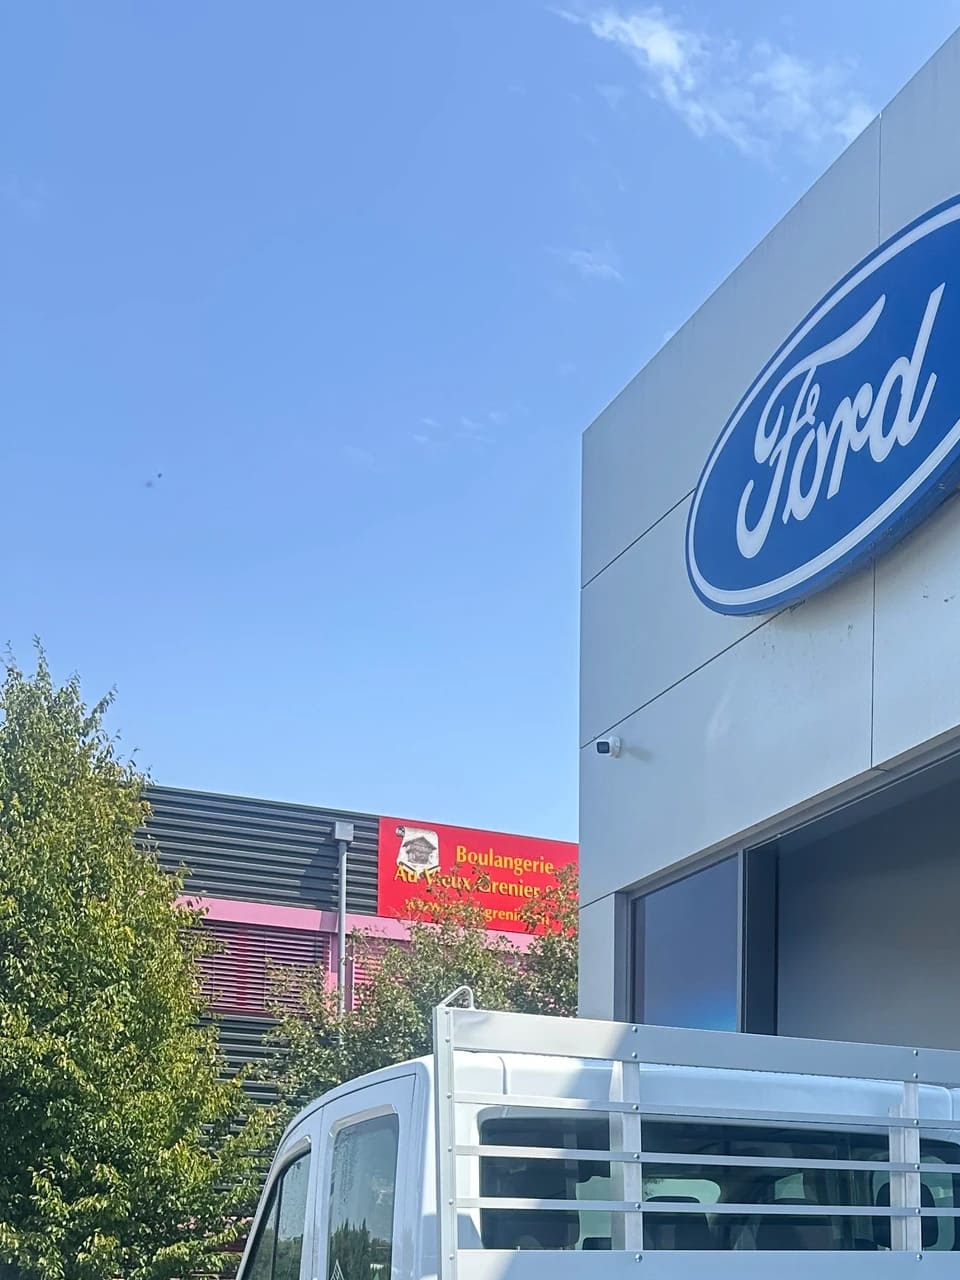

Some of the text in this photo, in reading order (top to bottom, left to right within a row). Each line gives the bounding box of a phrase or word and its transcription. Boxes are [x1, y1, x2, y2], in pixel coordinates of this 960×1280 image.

[736, 281, 945, 559] Ford
[394, 864, 417, 883] Au
[456, 845, 554, 876] Boulangerie
